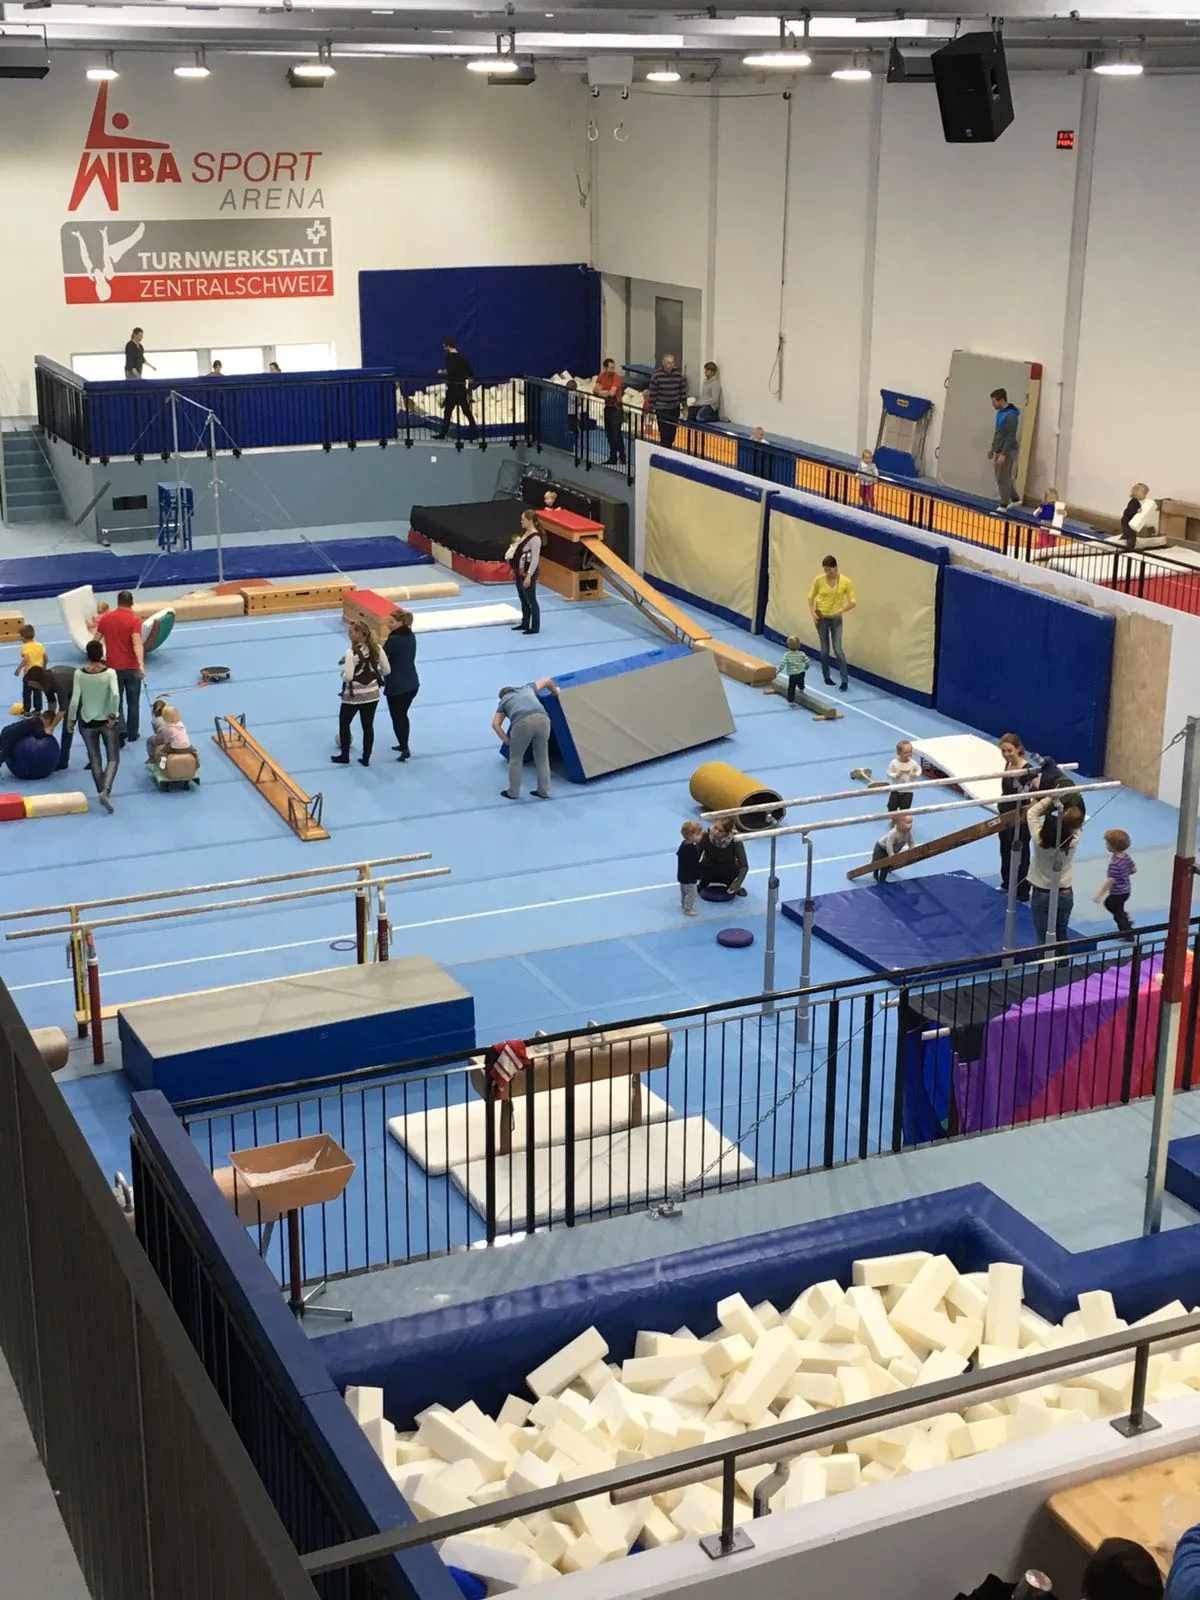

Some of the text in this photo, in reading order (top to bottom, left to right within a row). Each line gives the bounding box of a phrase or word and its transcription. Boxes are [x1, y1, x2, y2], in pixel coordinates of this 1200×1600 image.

[68, 151, 323, 211] WIBA SPORT
[219, 187, 325, 211] ARENA
[138, 248, 328, 270] TURNWERKSTATT
[140, 275, 328, 298] ZENTRALSCHWEIZ
